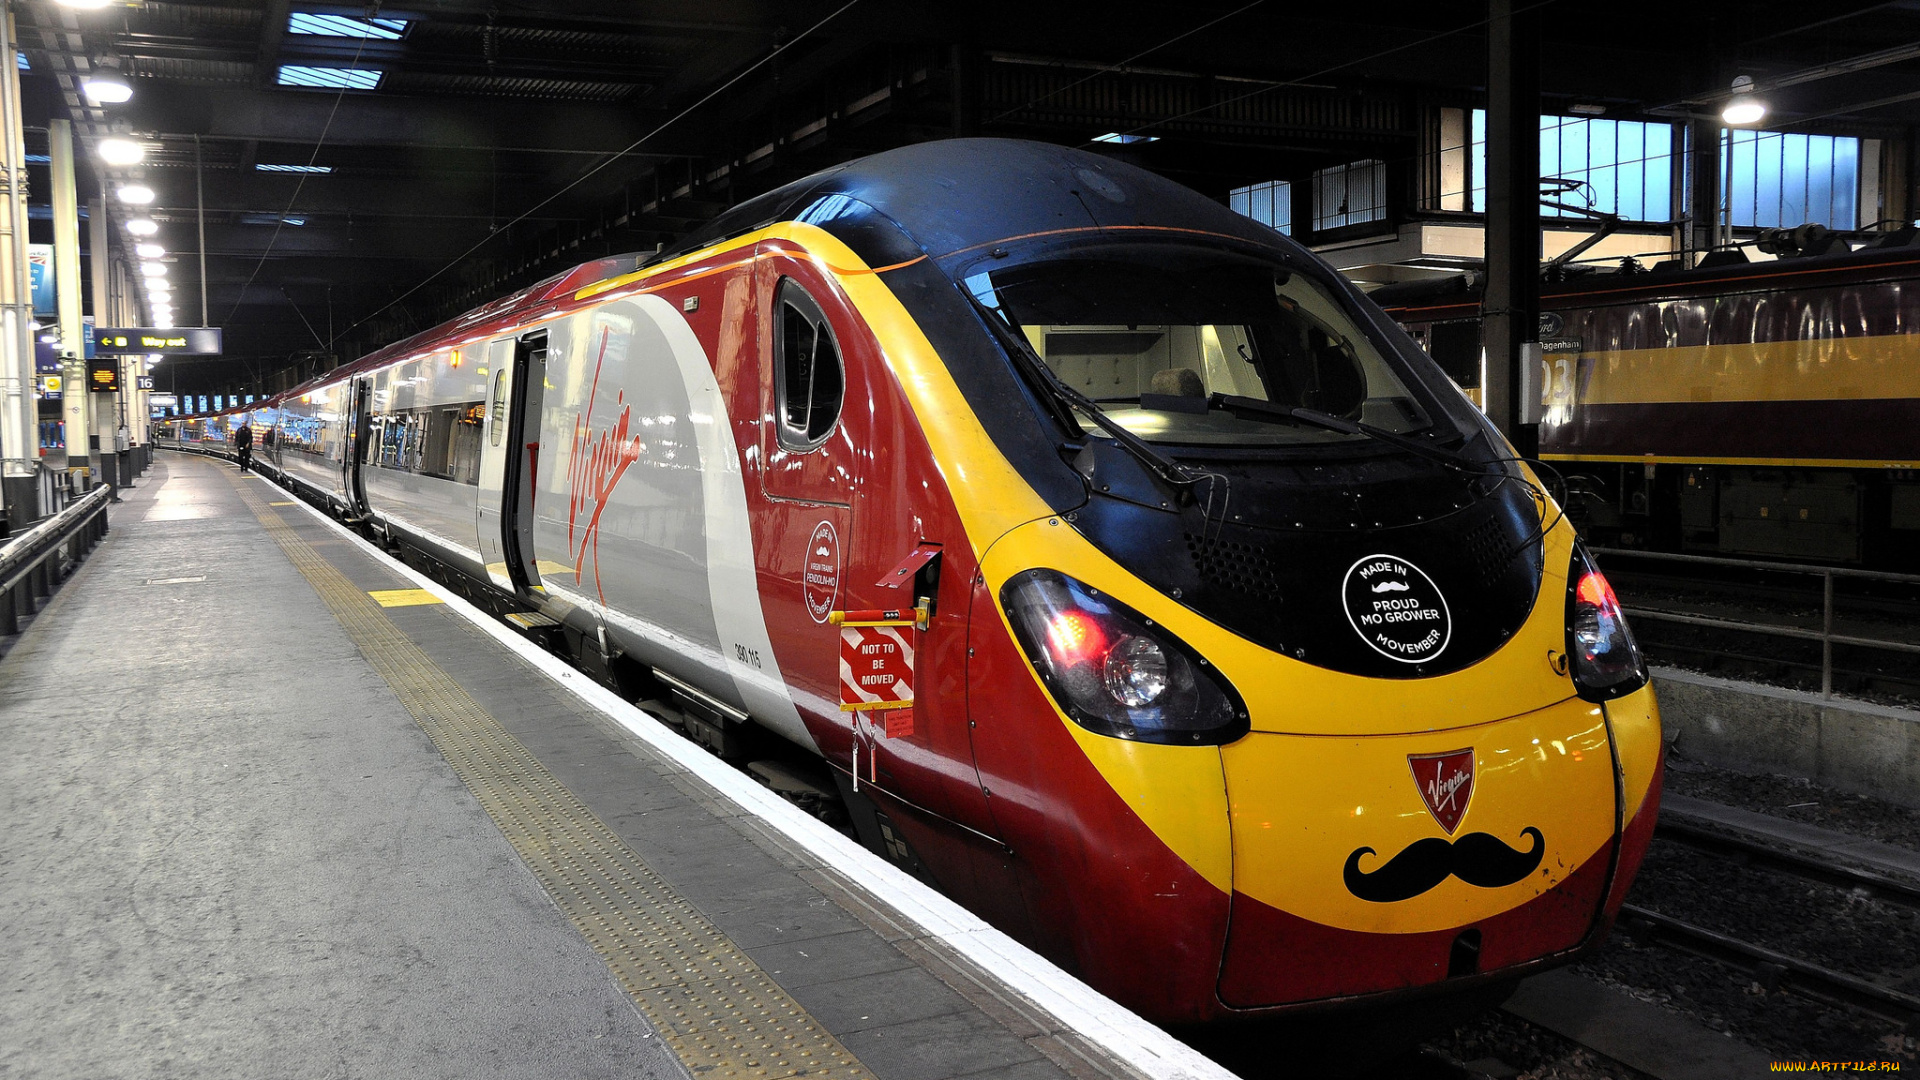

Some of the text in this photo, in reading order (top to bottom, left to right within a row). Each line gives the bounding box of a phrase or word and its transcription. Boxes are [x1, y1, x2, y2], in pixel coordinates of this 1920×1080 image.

[141, 336, 187, 348] Way out
[139, 378, 153, 388] 16
[566, 325, 641, 613] Virgin
[815, 528, 829, 542] MADE
[1359, 562, 1407, 579] MADE IN
[808, 591, 831, 615] MOVEMBER
[1373, 598, 1419, 611] PROUD
[1361, 609, 1440, 625] MO GROWER
[1376, 628, 1441, 653] MOVEMBER
[735, 643, 761, 669] 390 115
[861, 643, 895, 655] NOT TO
[872, 659, 884, 670] BE
[861, 674, 895, 685] MOVED
[1428, 761, 1470, 812] Virgin
